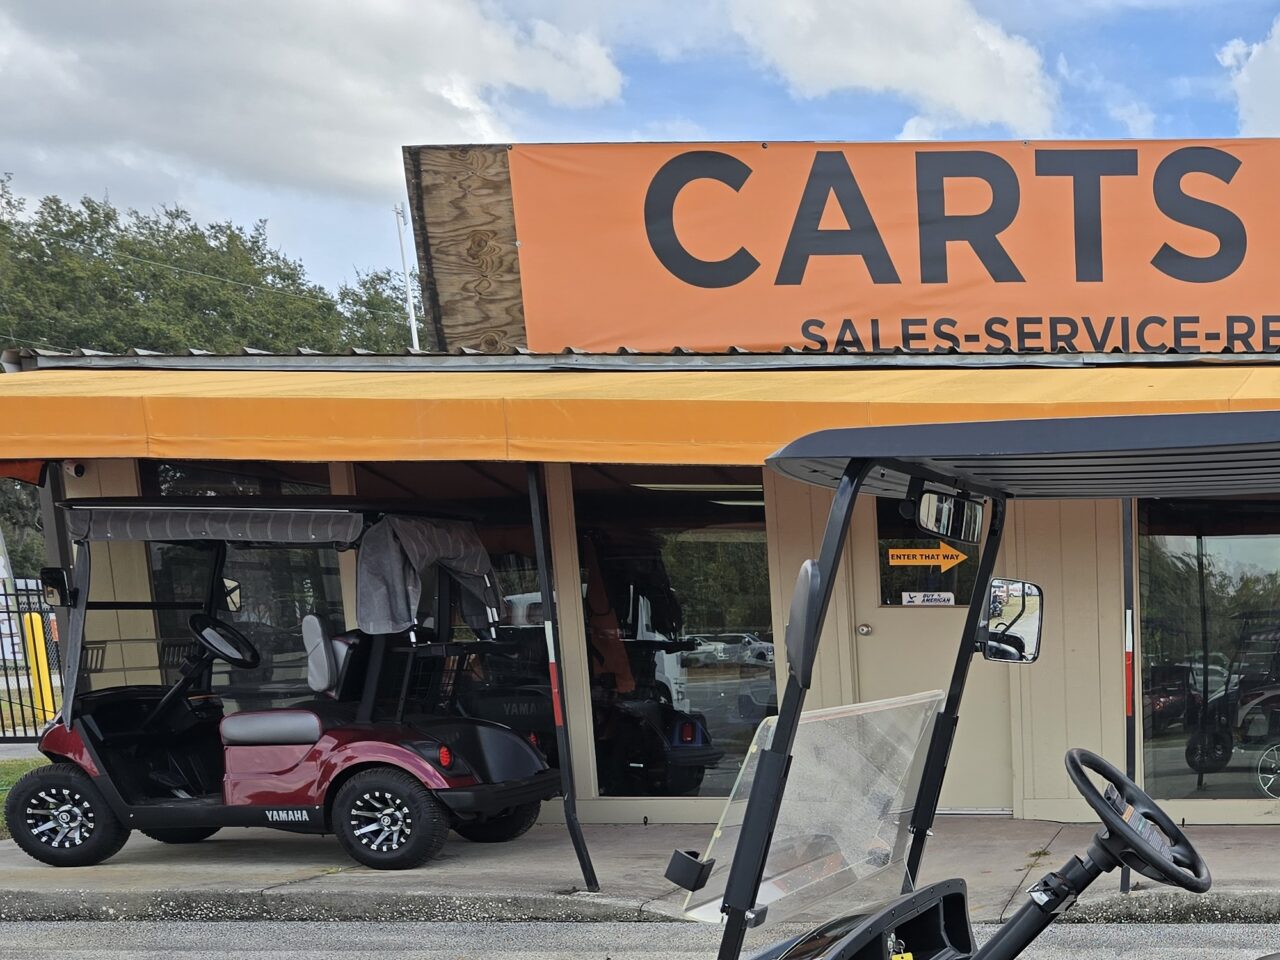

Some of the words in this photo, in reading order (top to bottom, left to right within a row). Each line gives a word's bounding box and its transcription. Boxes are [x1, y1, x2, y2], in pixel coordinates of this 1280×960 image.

[644, 146, 1248, 289] CARTS
[890, 553, 917, 561] ENTER
[265, 810, 309, 821] YAMAHA
